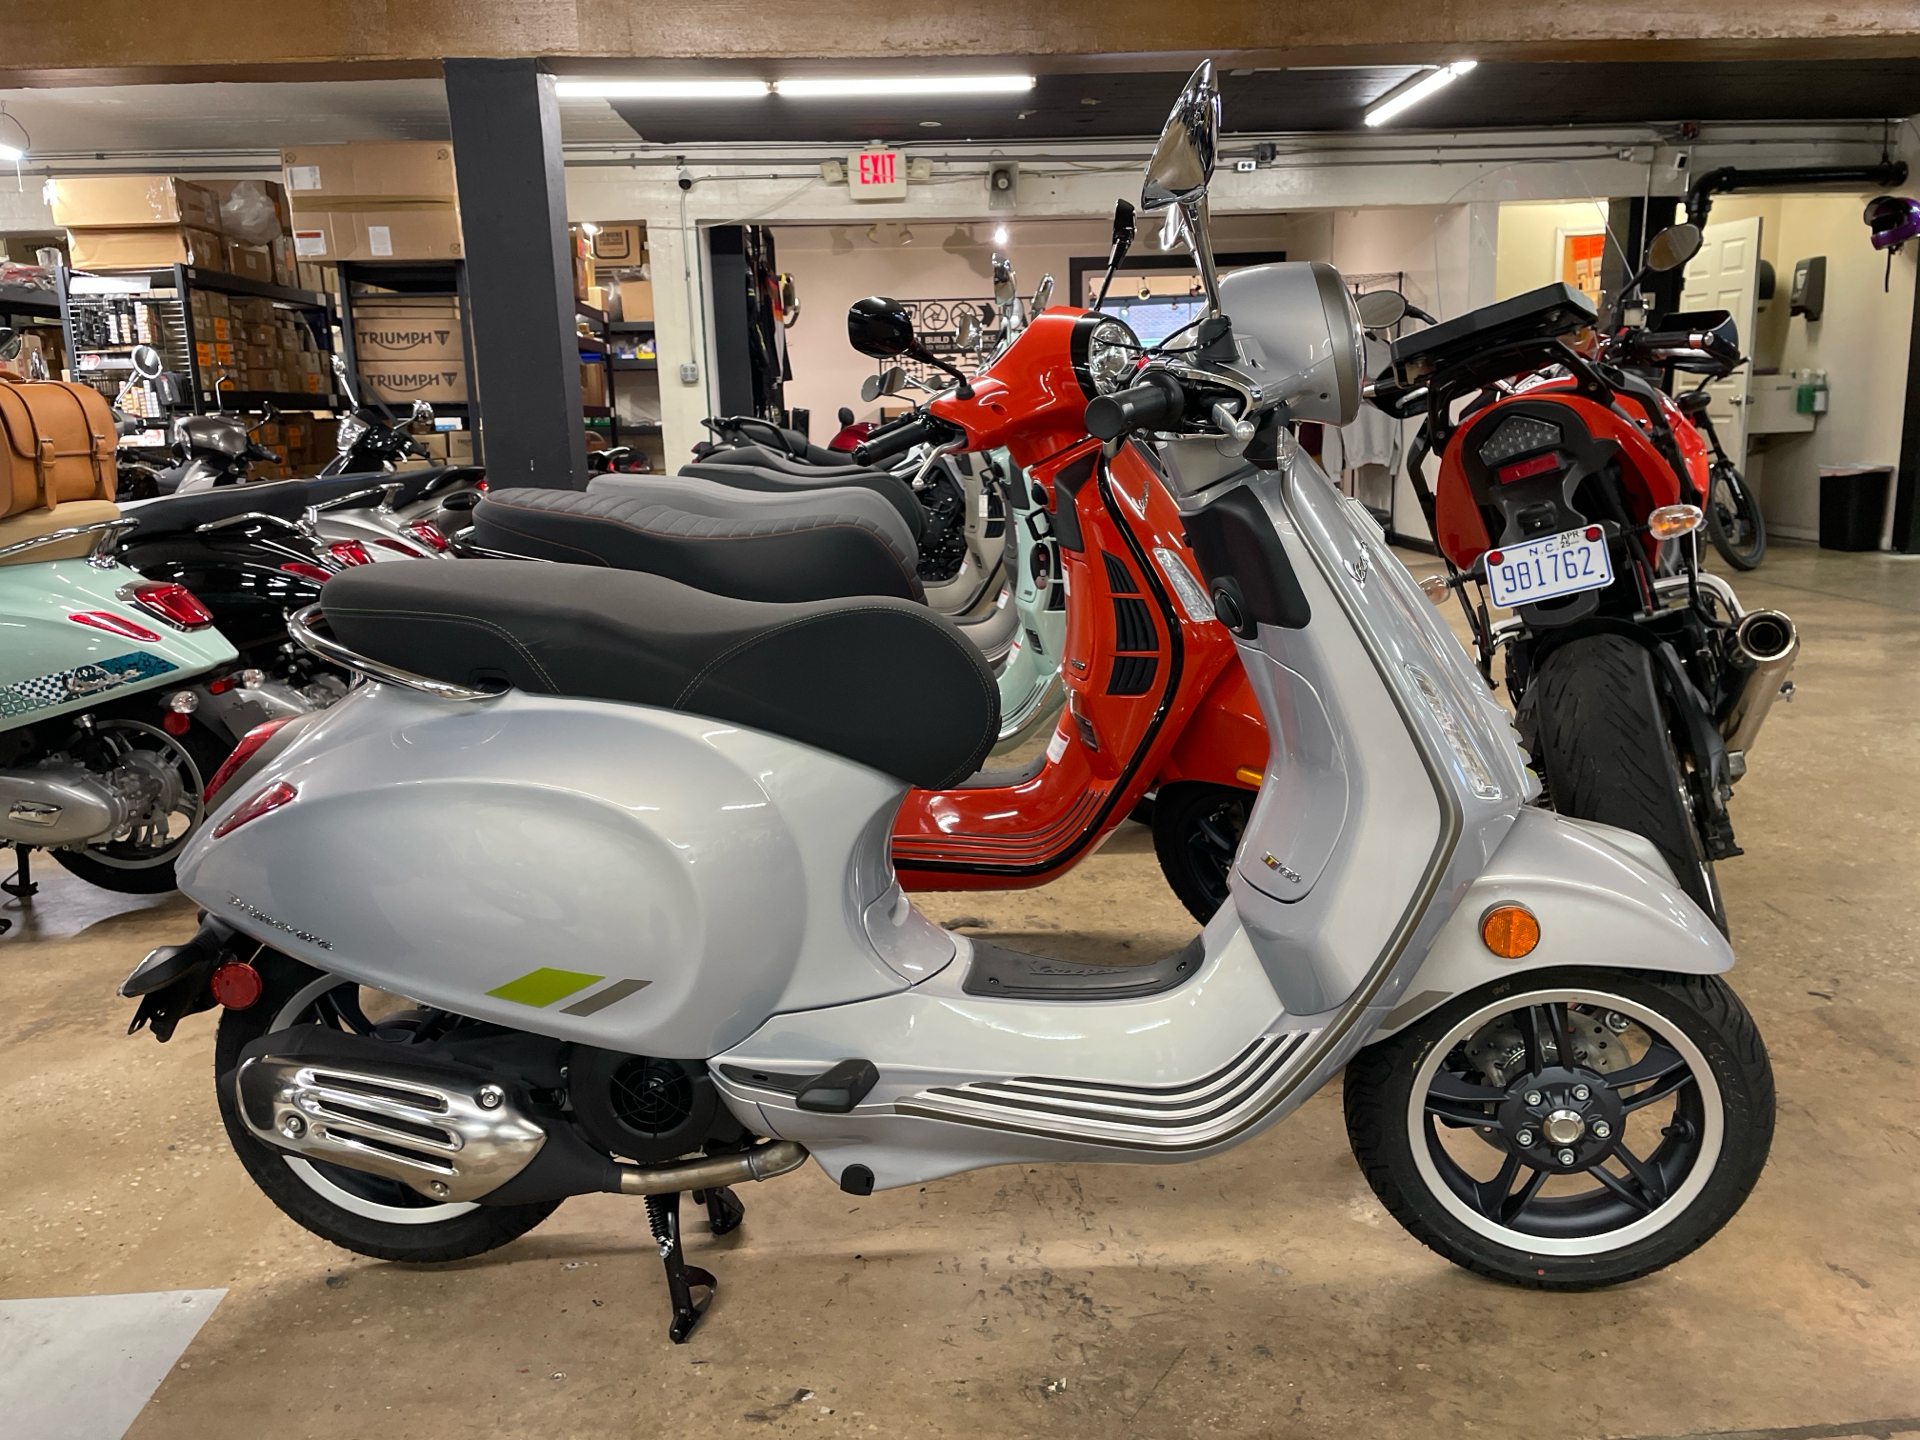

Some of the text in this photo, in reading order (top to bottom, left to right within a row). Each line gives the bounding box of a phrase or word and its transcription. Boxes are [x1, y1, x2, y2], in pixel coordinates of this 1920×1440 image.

[859, 153, 896, 185] EXIT
[358, 331, 432, 350] TRIUMPH
[925, 336, 950, 344] BUILD
[365, 374, 440, 392] TRIUMPH
[1560, 530, 1580, 542] APR
[1560, 540, 1571, 549] 25
